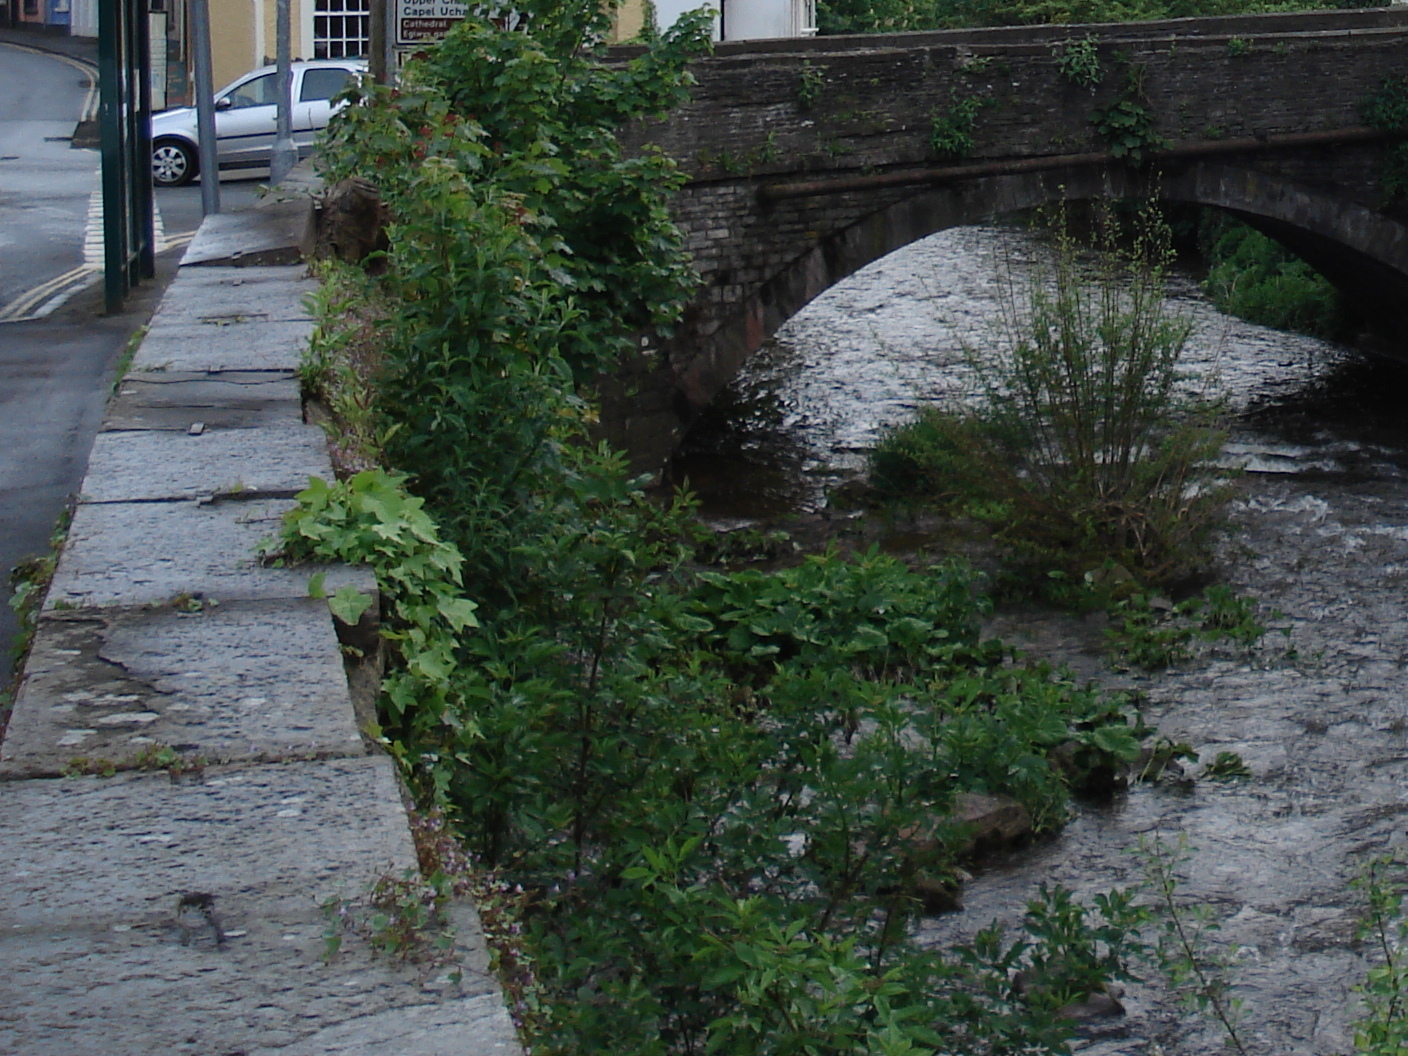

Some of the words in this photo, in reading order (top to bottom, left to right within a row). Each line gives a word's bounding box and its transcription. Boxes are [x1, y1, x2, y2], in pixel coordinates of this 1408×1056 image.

[403, 7, 435, 17] Capel
[440, 7, 467, 16] Ucha
[403, 20, 447, 28] Cathedral
